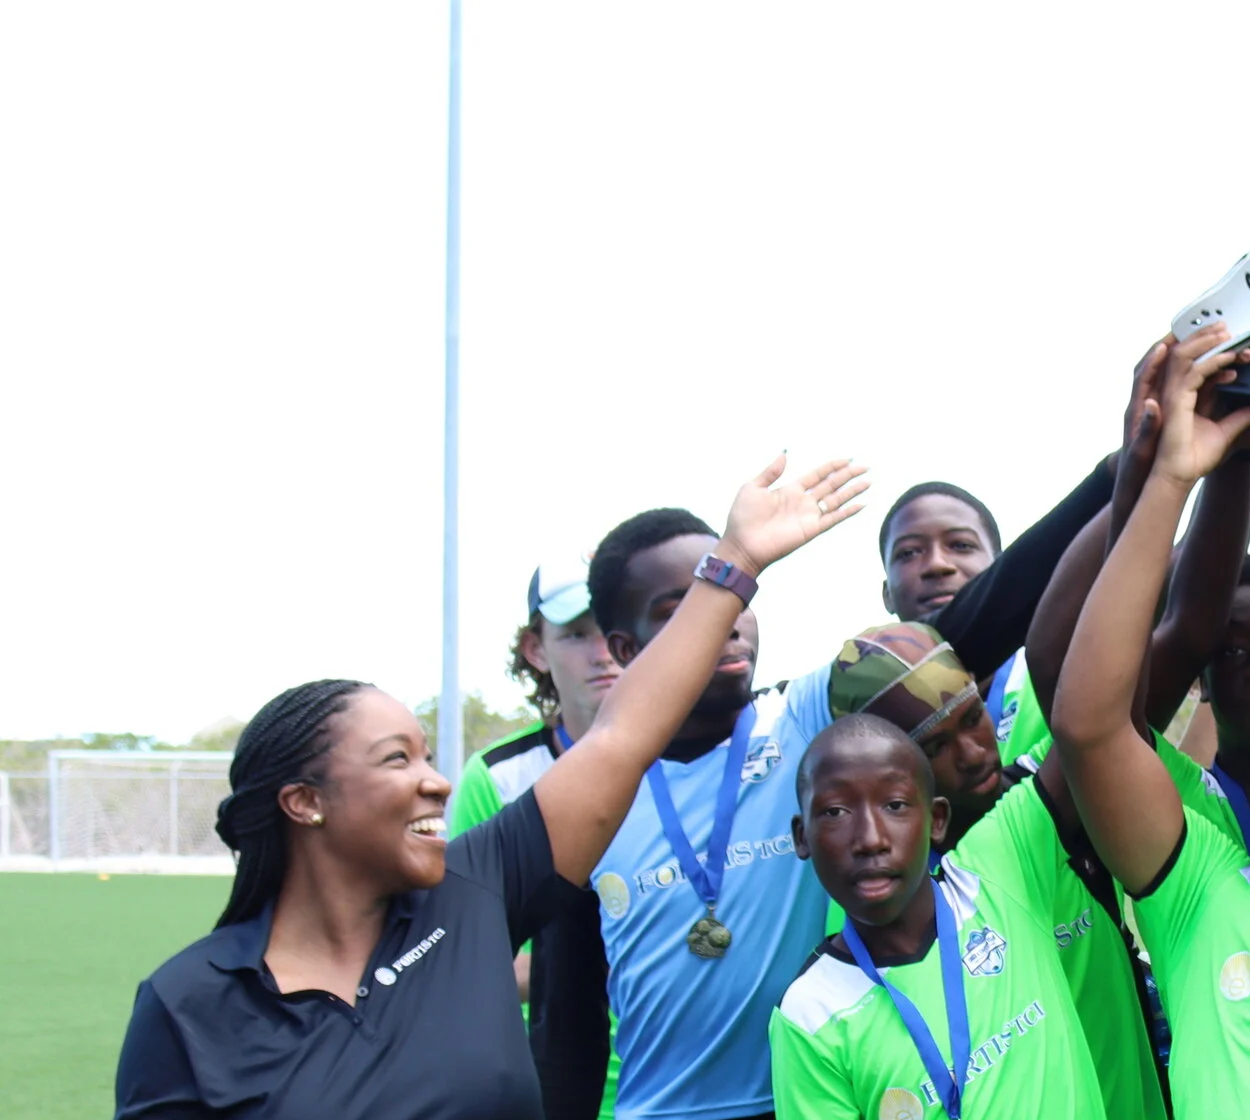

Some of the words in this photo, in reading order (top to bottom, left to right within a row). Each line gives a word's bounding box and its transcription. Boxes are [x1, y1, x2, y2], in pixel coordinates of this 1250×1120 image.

[633, 841, 754, 894] FOIS
[1070, 907, 1093, 937] TC
[391, 939, 432, 973] FORTIS
[427, 927, 446, 944] TCI
[920, 1024, 1013, 1106] FRTIS
[1010, 1000, 1046, 1037] TCI
